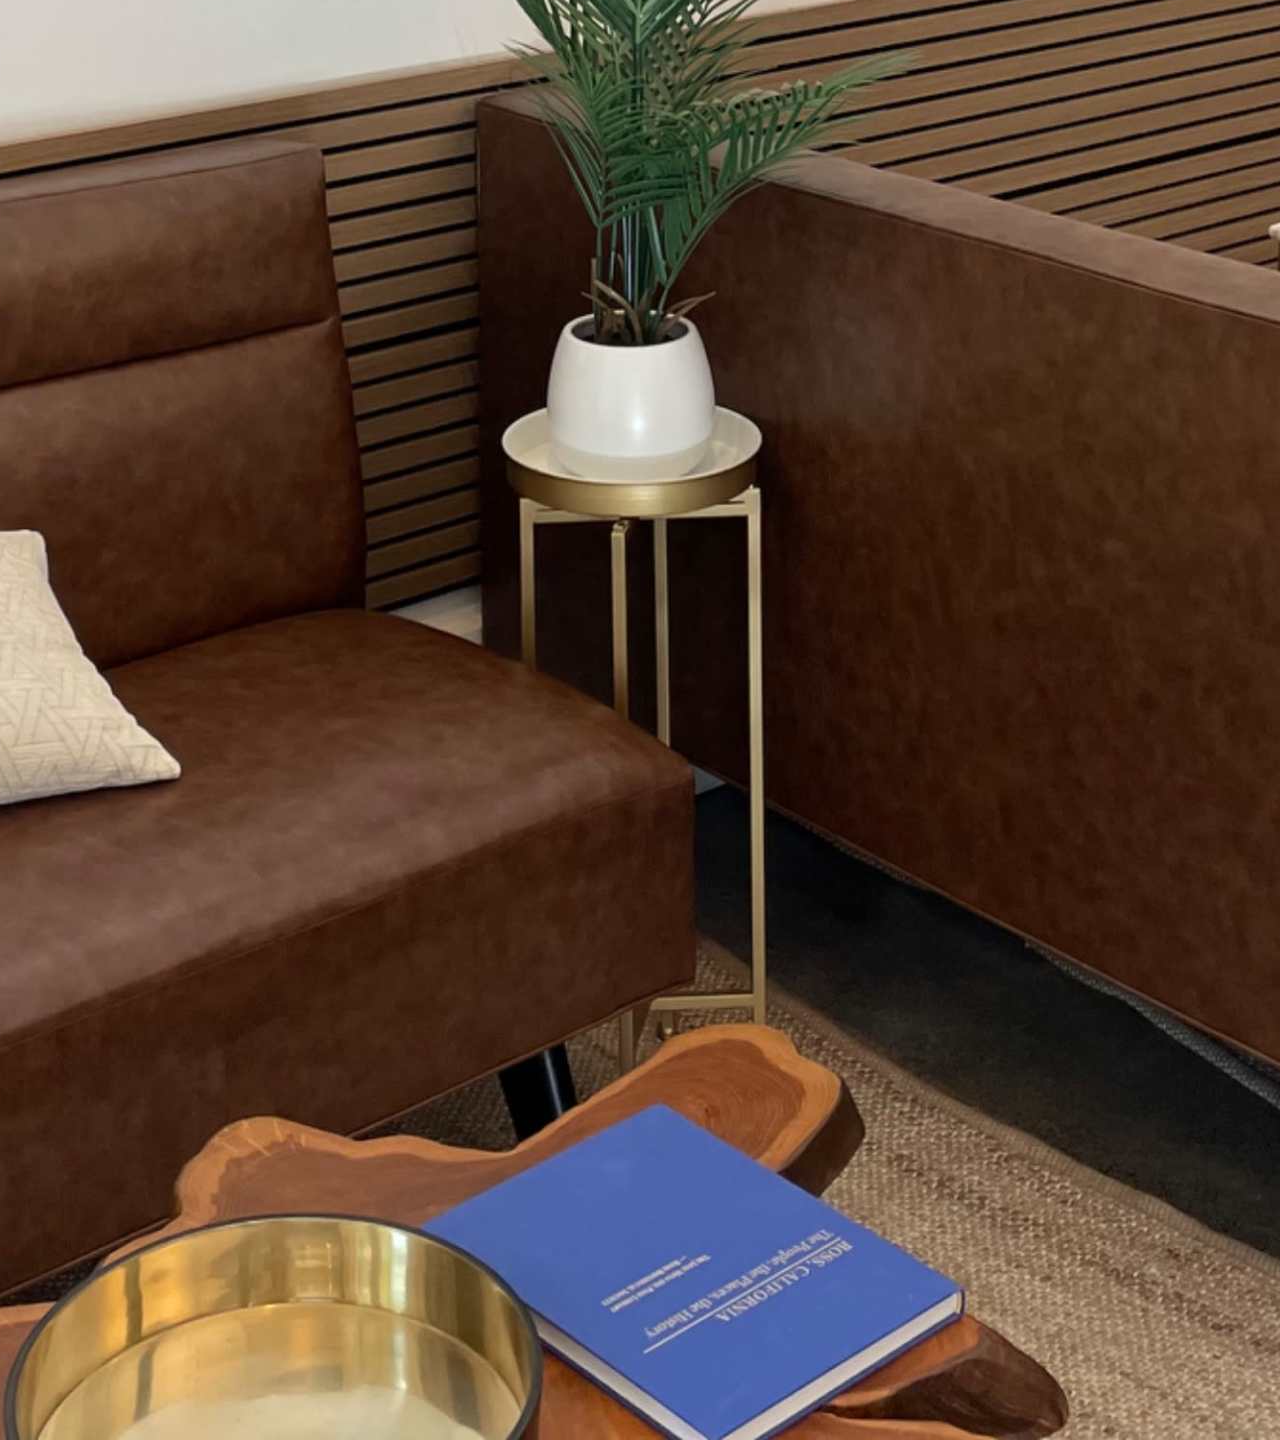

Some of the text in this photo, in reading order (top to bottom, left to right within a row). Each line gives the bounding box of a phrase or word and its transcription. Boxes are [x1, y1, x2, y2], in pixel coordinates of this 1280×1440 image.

[808, 1229, 835, 1244] The
[716, 1265, 810, 1321] CALIFORNIA
[644, 1308, 695, 1338] History
